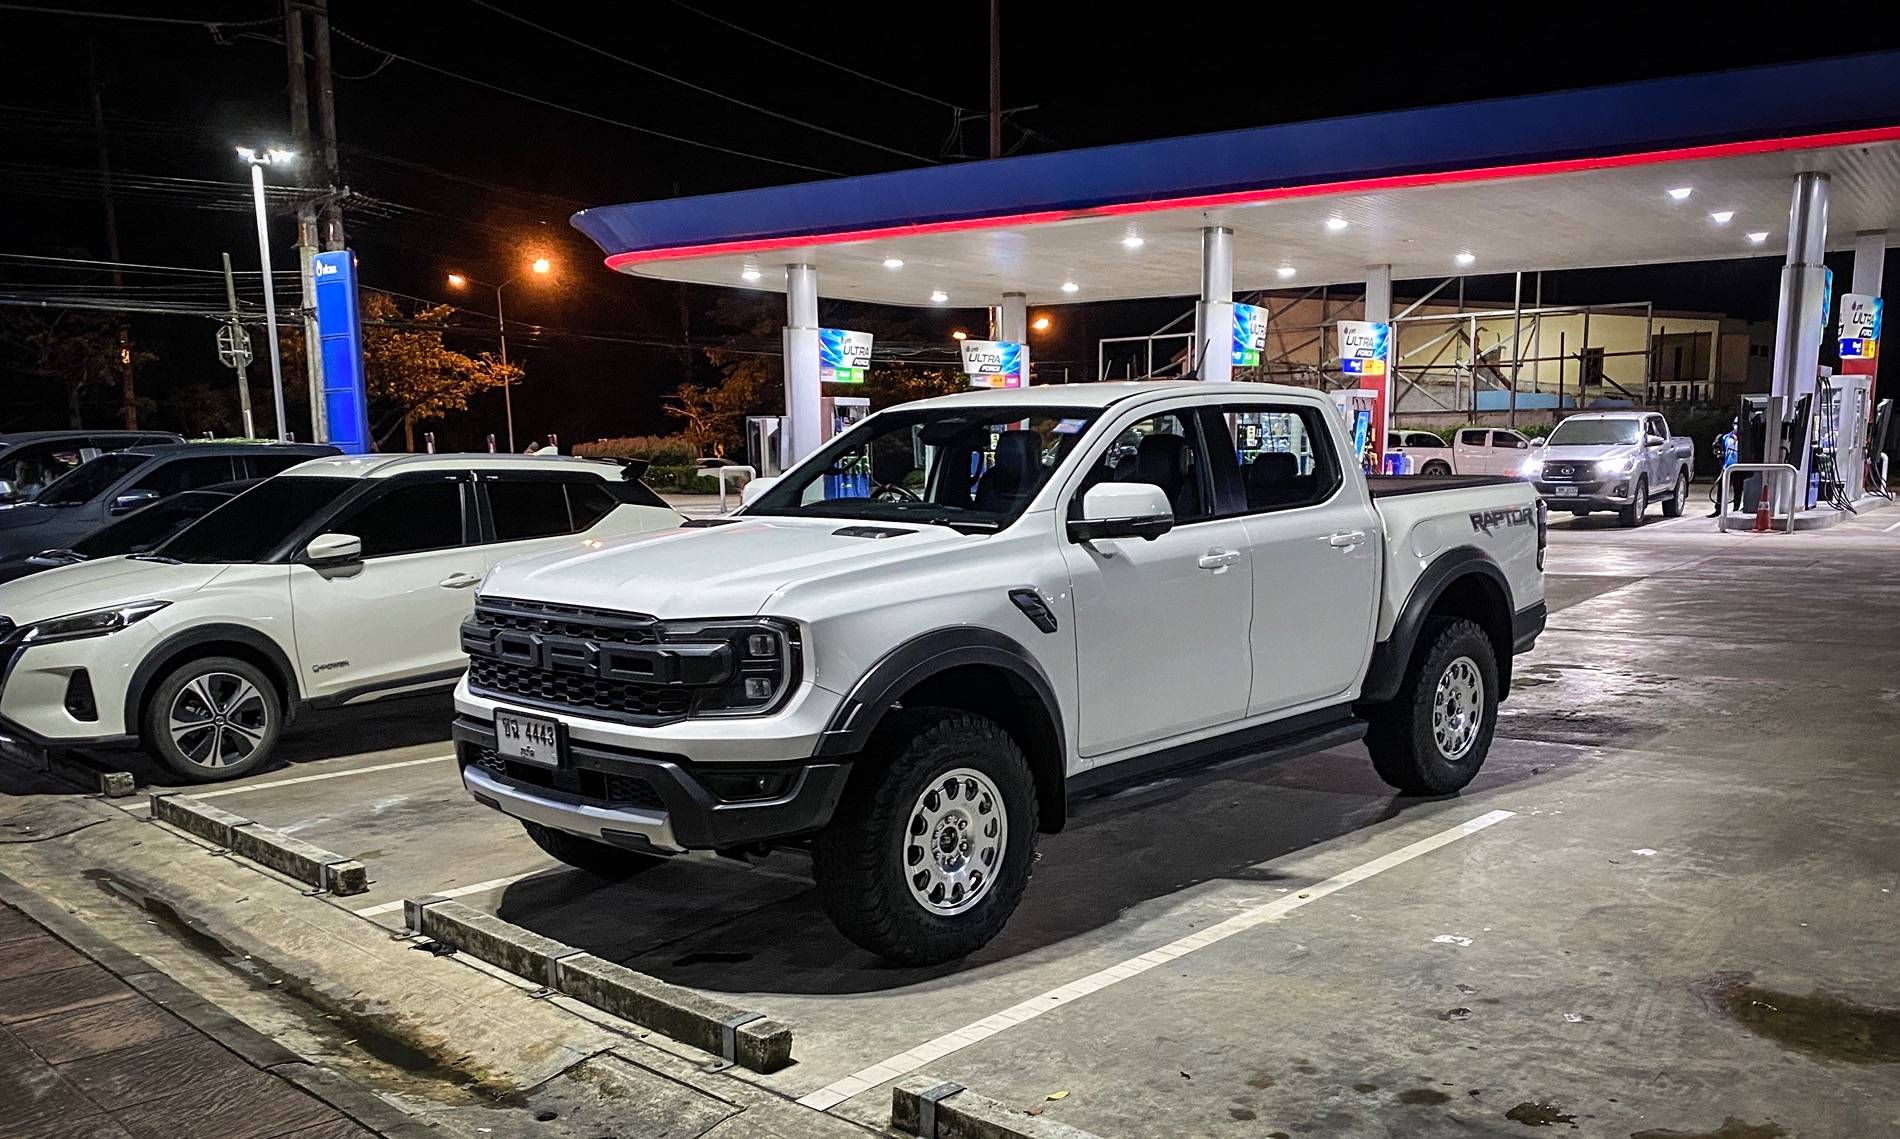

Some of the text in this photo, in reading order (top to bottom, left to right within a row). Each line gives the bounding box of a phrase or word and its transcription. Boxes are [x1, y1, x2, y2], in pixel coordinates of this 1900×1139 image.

[1345, 336, 1374, 347] ULTRA
[843, 345, 870, 356] ULTRA
[968, 353, 1001, 364] ULTRA
[981, 364, 1001, 372] FORCE
[1469, 507, 1536, 538] RAPTOR
[460, 624, 675, 684] FORD
[525, 722, 555, 746] 4443
